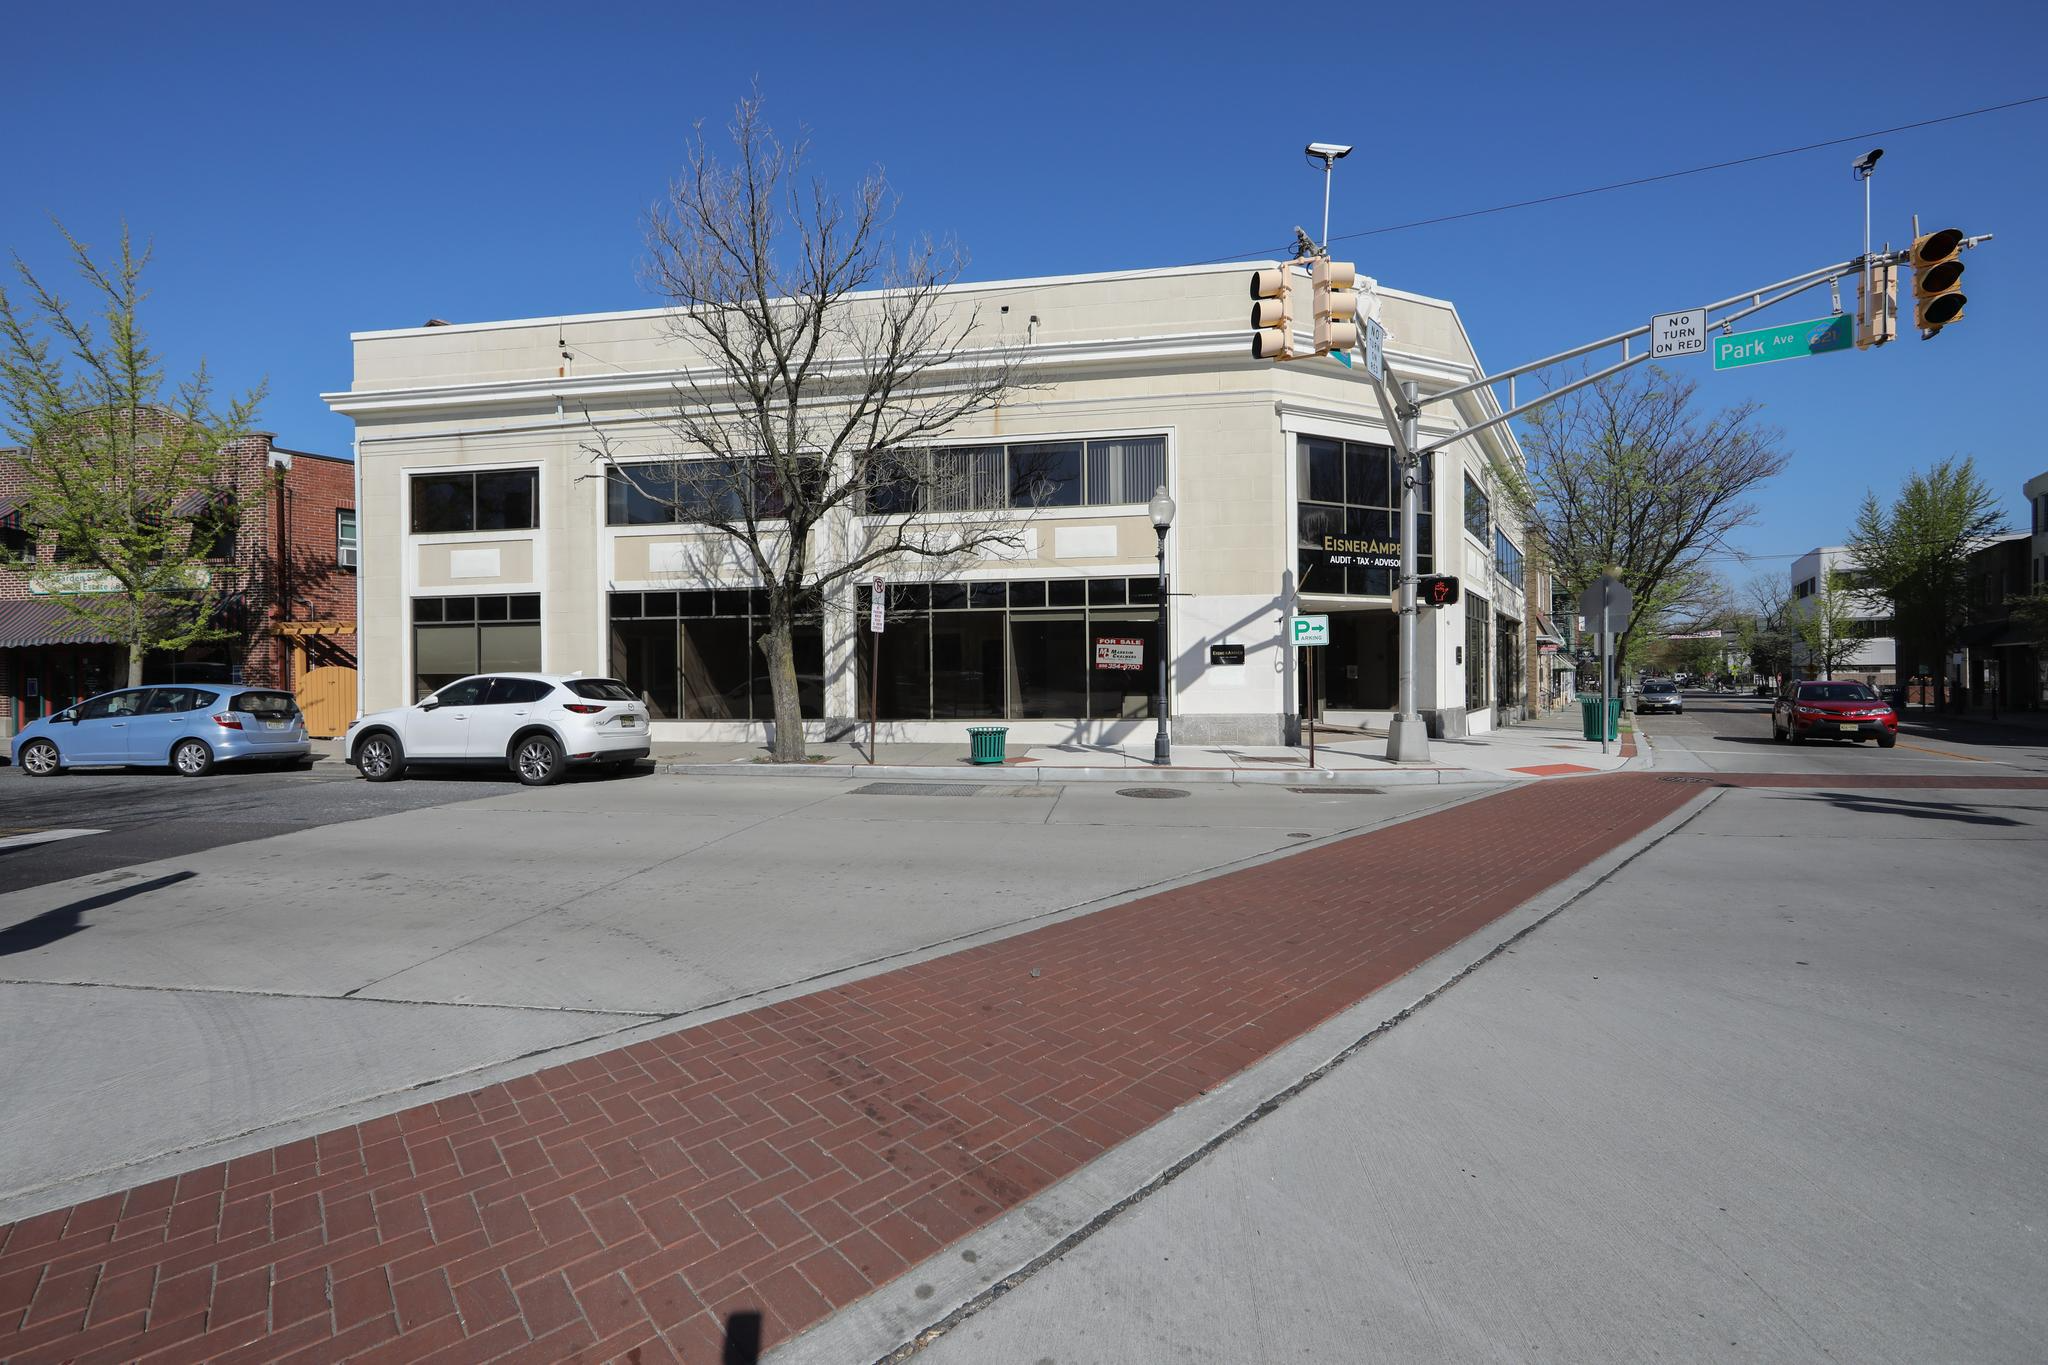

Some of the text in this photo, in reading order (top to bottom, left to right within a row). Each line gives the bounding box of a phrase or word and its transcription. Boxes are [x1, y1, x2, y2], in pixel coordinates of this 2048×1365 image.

[1669, 316, 1690, 327] NO
[1370, 325, 1380, 340] NO
[1663, 328, 1695, 340] TURN
[1656, 339, 1702, 353] ON RED
[1721, 340, 1765, 361] Park
[1773, 334, 1794, 346] Ave
[1324, 535, 1401, 556] EISNERAMPE
[1329, 555, 1401, 567] AUDIT TAX ADVISO
